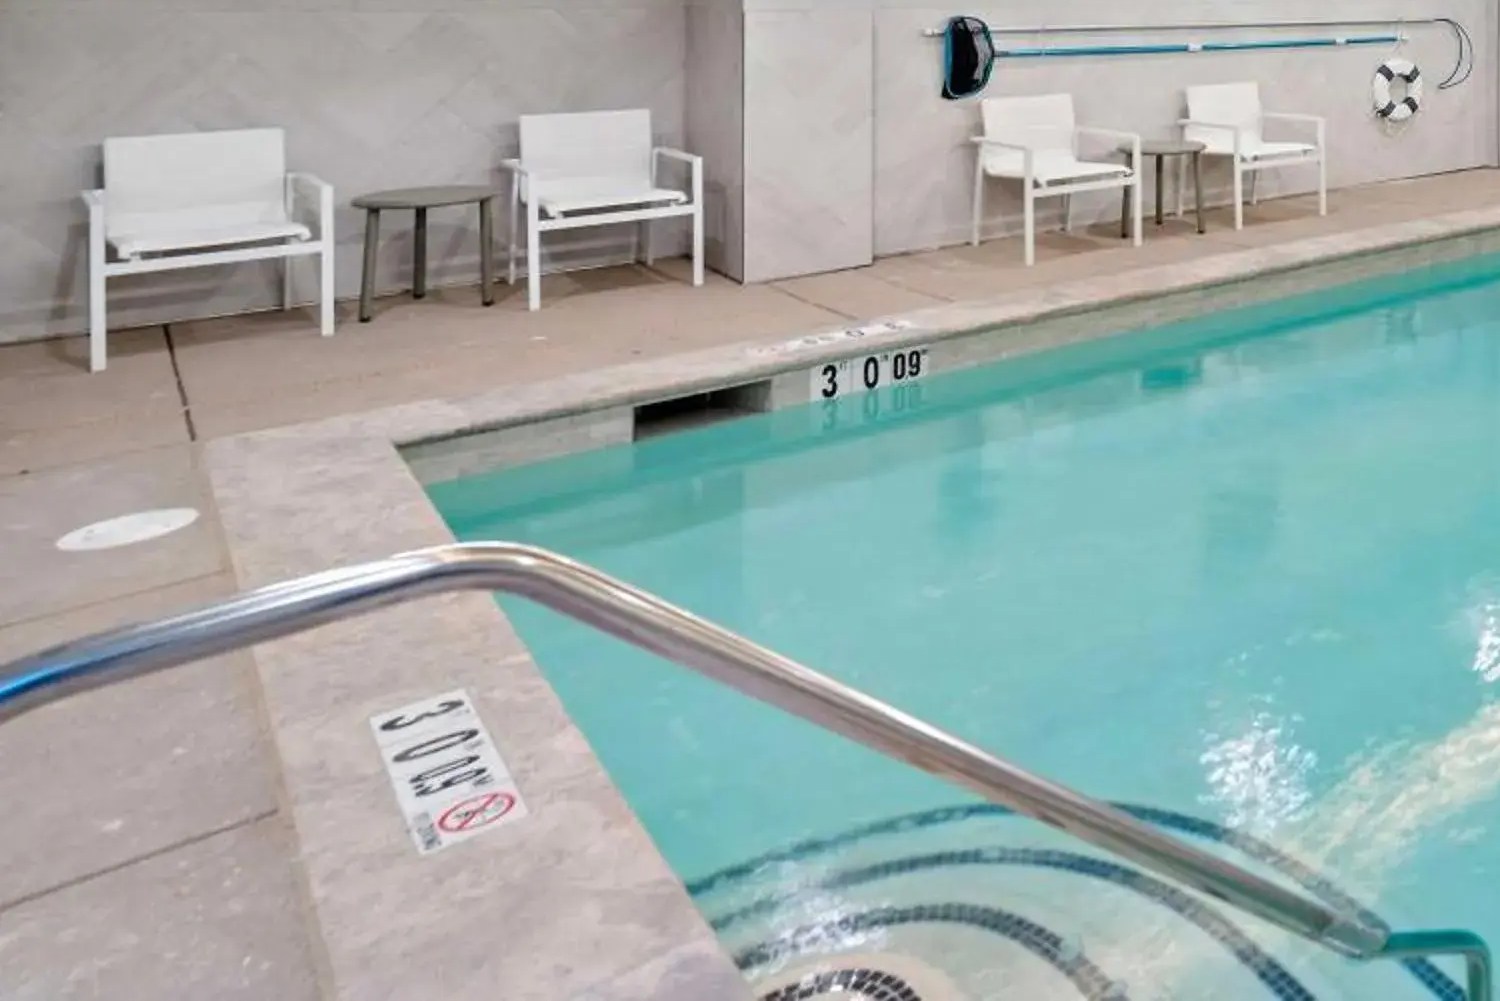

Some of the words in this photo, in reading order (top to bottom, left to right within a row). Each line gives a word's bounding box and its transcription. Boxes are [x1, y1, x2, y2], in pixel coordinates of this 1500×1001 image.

[822, 364, 838, 398] 3
[863, 356, 879, 390] 0
[380, 699, 465, 731] 3
[392, 729, 480, 763] 0
